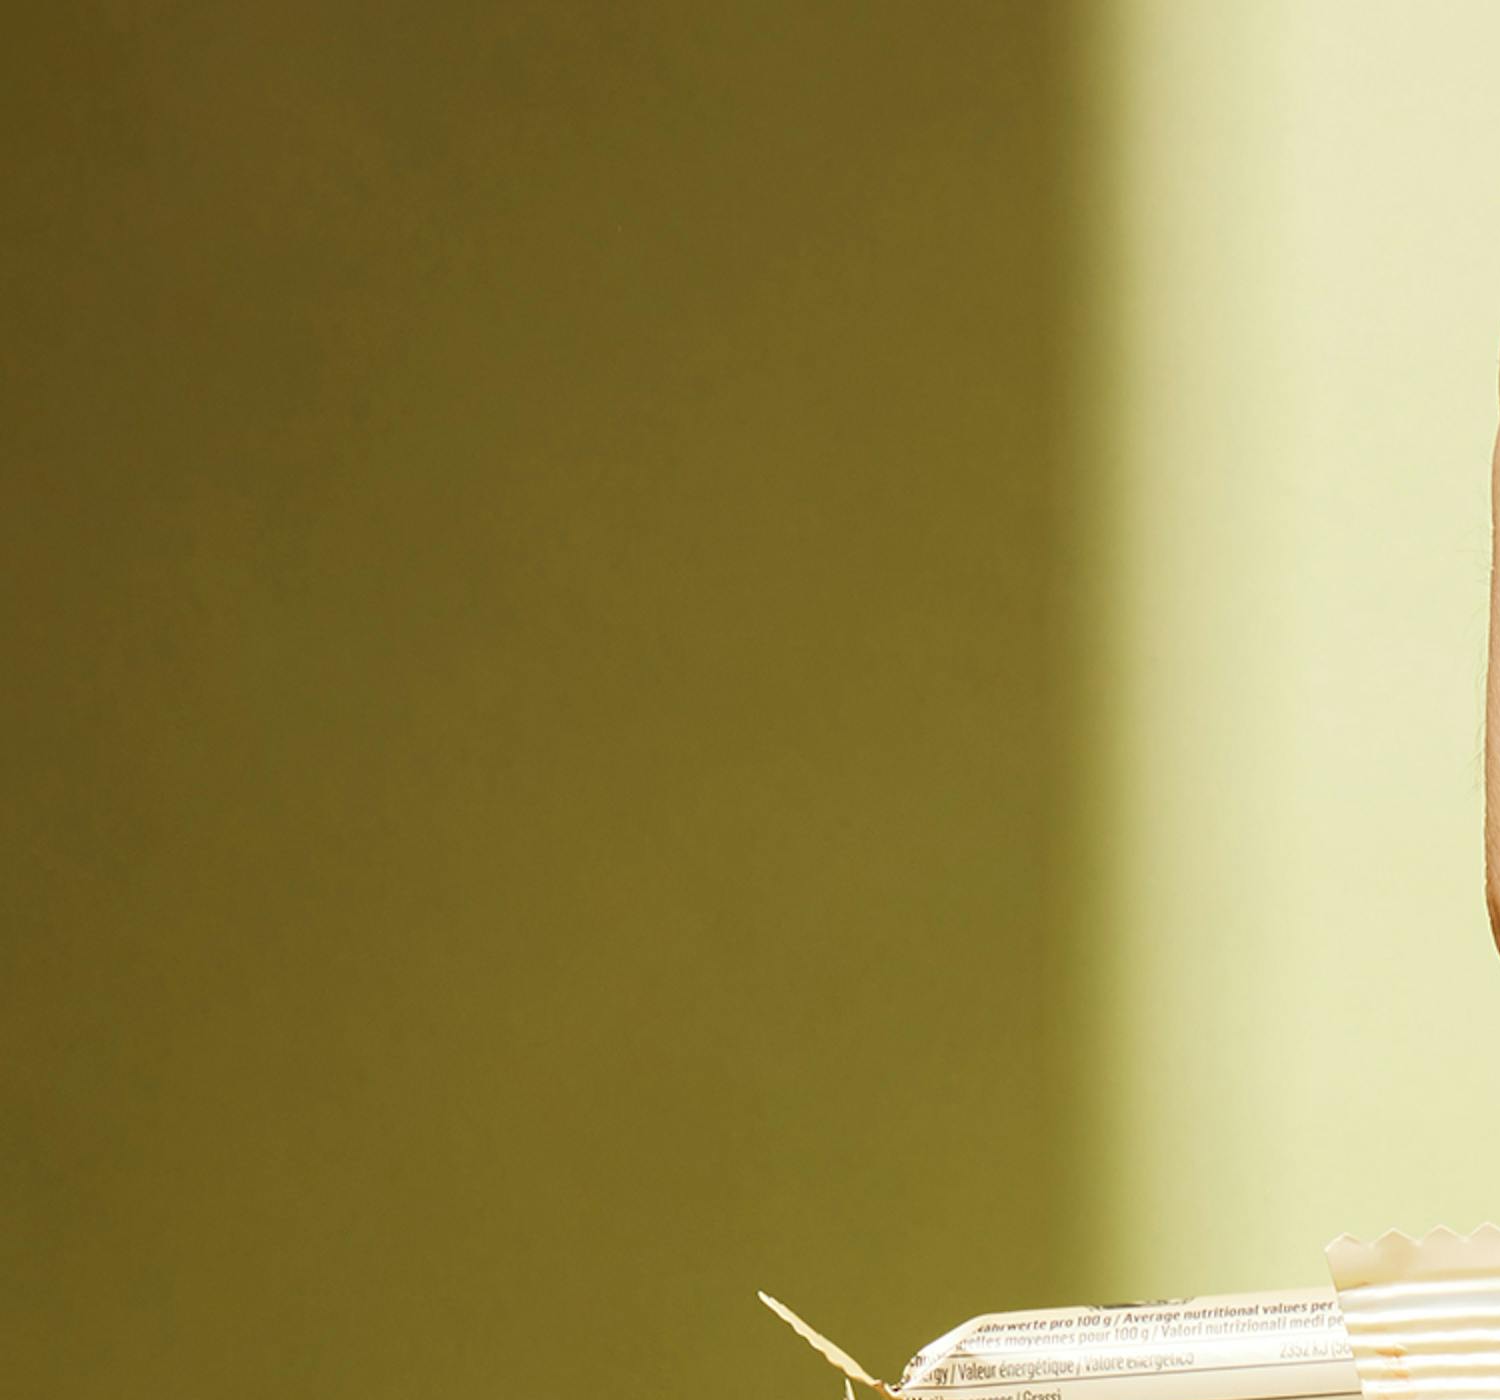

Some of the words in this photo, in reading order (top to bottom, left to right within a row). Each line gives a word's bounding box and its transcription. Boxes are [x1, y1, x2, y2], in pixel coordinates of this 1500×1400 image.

[1125, 1311, 1180, 1325] Average
[1184, 1304, 1259, 1320] nutritional
[1262, 1301, 1308, 1315] values
[1311, 1300, 1334, 1313] per
